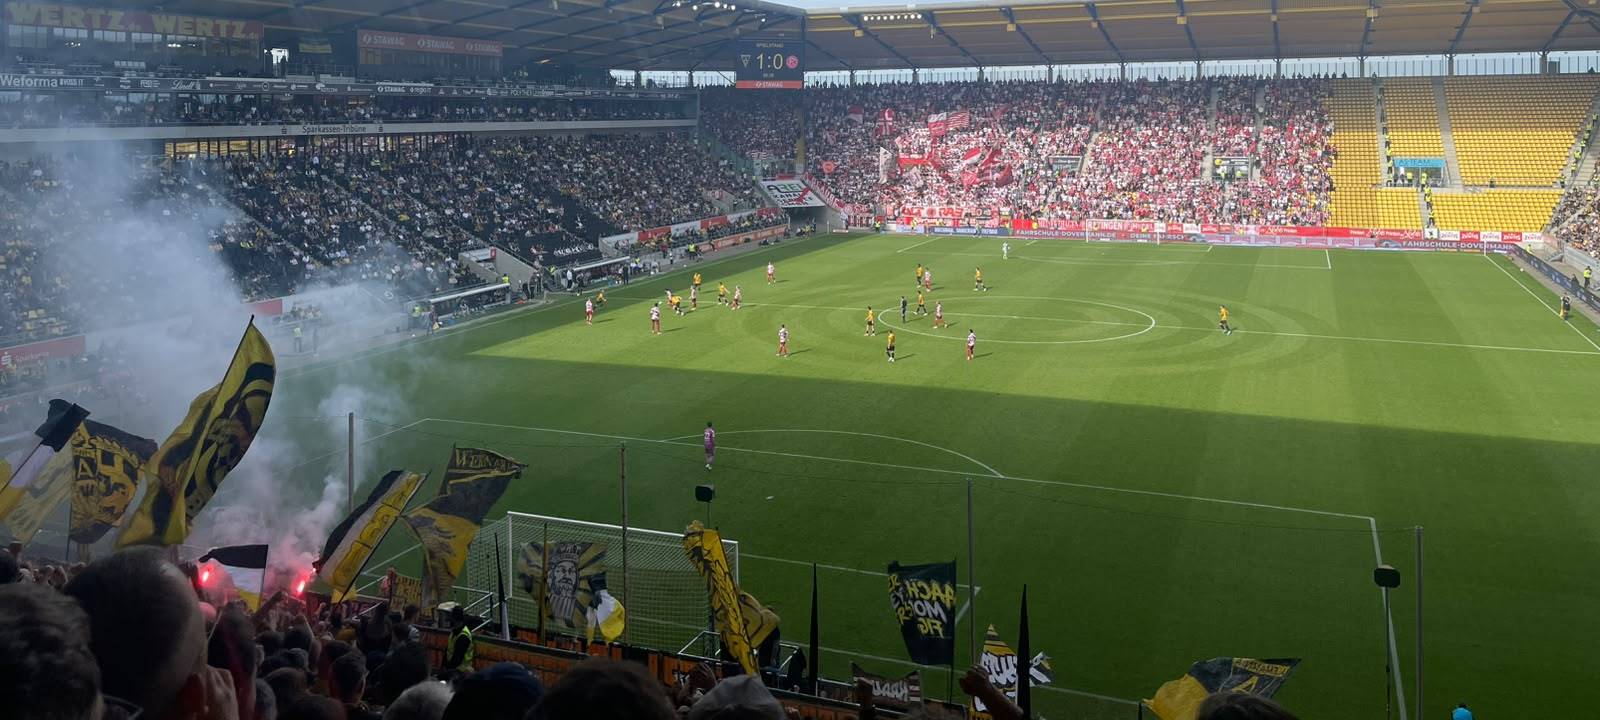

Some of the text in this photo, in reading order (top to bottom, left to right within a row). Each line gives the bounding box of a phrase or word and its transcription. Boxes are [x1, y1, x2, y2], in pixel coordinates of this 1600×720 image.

[373, 34, 405, 46] STAWAG
[426, 39, 455, 50] STAWAG
[756, 53, 783, 70] 1:0
[0, 73, 58, 88] Weforma
[171, 80, 195, 90] Lindt
[303, 124, 366, 135] Sparkassen-Tribüne
